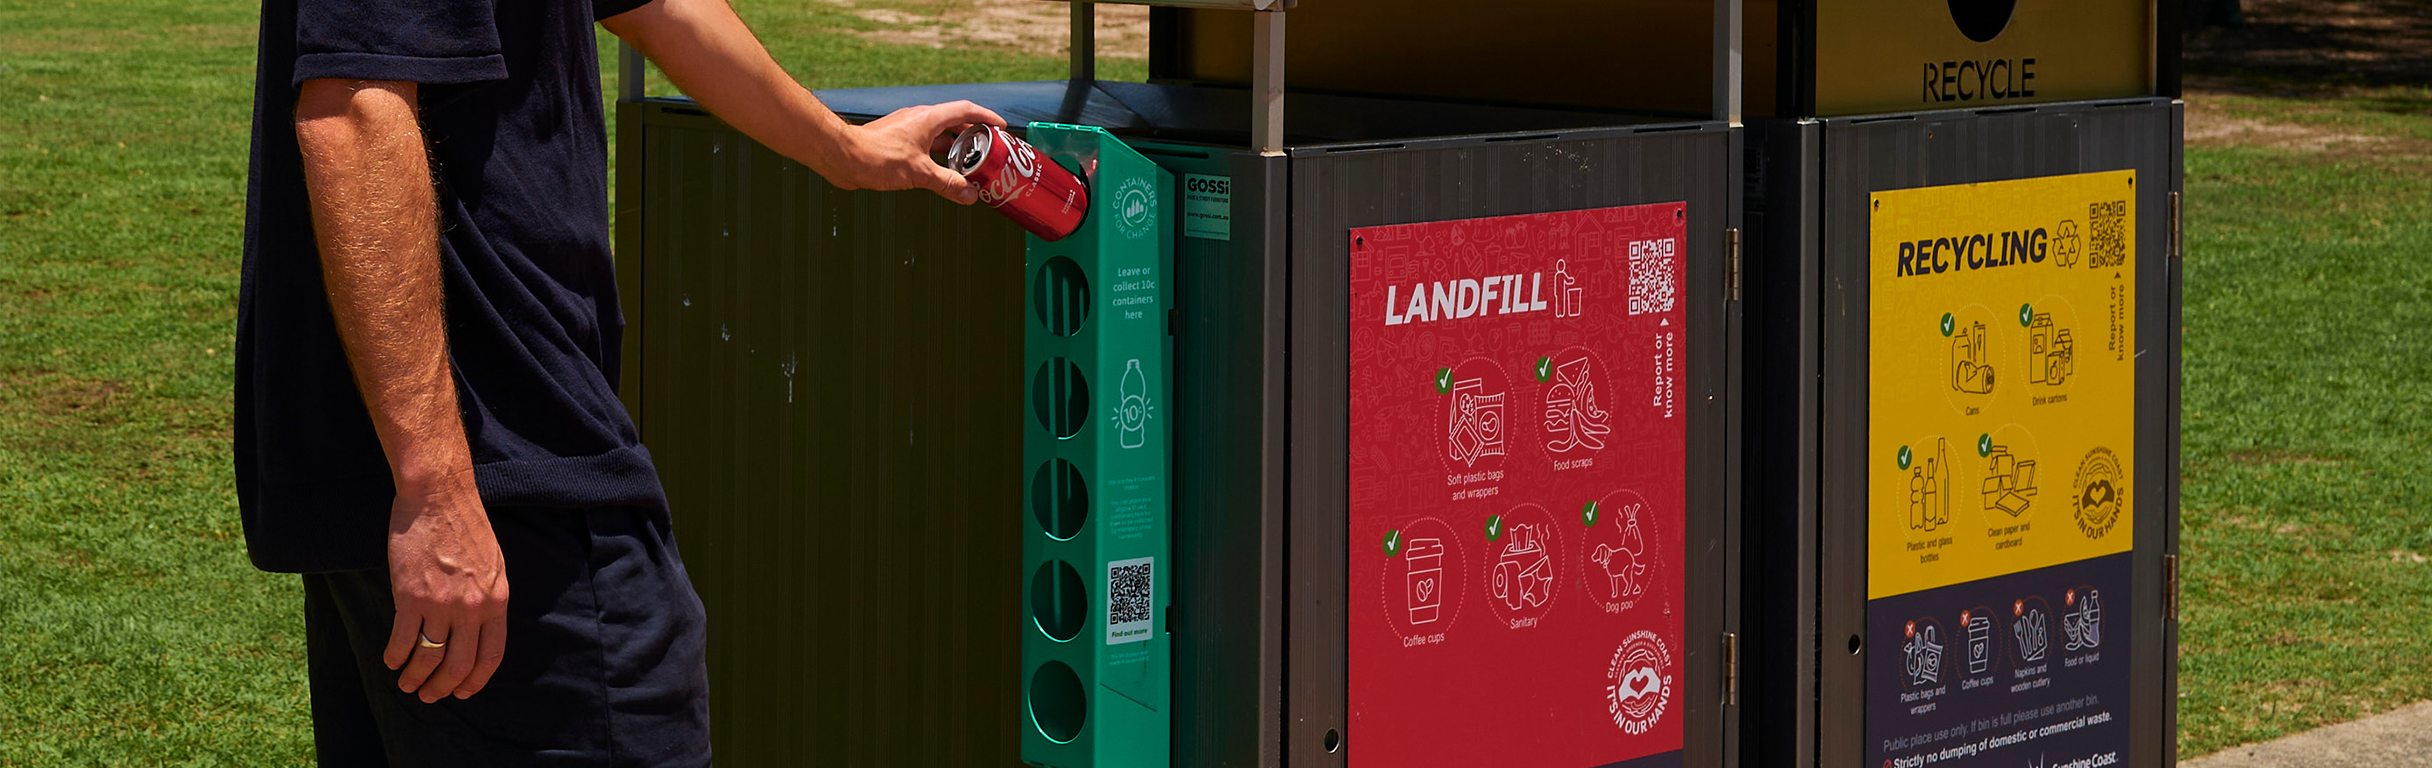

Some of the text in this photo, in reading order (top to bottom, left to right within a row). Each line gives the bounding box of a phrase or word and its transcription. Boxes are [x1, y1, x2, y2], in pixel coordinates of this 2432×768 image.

[1922, 58, 2036, 103] RECYCLE
[1113, 177, 1157, 210] CONTAINERS
[1187, 178, 1229, 195] GOSSi
[1114, 212, 1156, 239] FOR CHANGE
[1897, 227, 2047, 278] RECYCLING
[1118, 267, 1151, 277] Leave or
[1113, 279, 1155, 291] collect 10c
[1112, 295, 1154, 306] containers
[1385, 272, 1548, 326] LANDFILL
[1125, 309, 1143, 320] here
[2109, 285, 2117, 351] Report or
[2117, 324, 2125, 361] know
[1654, 333, 1664, 407] Report or
[1664, 376, 1673, 418] know
[2032, 394, 2067, 406] Drink cartons
[1966, 406, 1980, 416] Cans
[1554, 457, 1593, 471] Food scraps
[1447, 469, 1504, 486] Soft plastic bags
[2073, 459, 2085, 489] CLEAN
[1452, 485, 1499, 500] and wrappers
[2077, 517, 2087, 533] IN
[2086, 526, 2104, 540] OUR
[2104, 487, 2124, 534] HANDS
[1987, 522, 2031, 538] Clean paper and
[1907, 536, 1953, 552] Plastic and glass
[1995, 537, 2023, 550] cardboard
[1920, 553, 1939, 564] bottles
[1605, 600, 1634, 614] Dog poo
[1510, 616, 1538, 629] Sanitary
[1403, 632, 1445, 648] Coffee cups
[1607, 645, 1624, 678] CLEAN
[1622, 630, 1657, 647] SUNSHINE
[1656, 638, 1672, 667] COAST
[2064, 652, 2100, 668] Food or liquid
[2014, 664, 2047, 679] Napkins and
[1962, 675, 1994, 690] Coffee cups
[2010, 676, 2051, 693] wooden cutlery
[1900, 685, 1946, 703] Plastic bags and
[1606, 674, 1672, 735] IT'S IN OUR HANDS
[1910, 702, 1936, 715] wrappers
[1883, 693, 2100, 753] Public place use only. If bin is full please use another bin.
[1893, 710, 2112, 768] Strictly no dumping of domestic or commercial waste.
